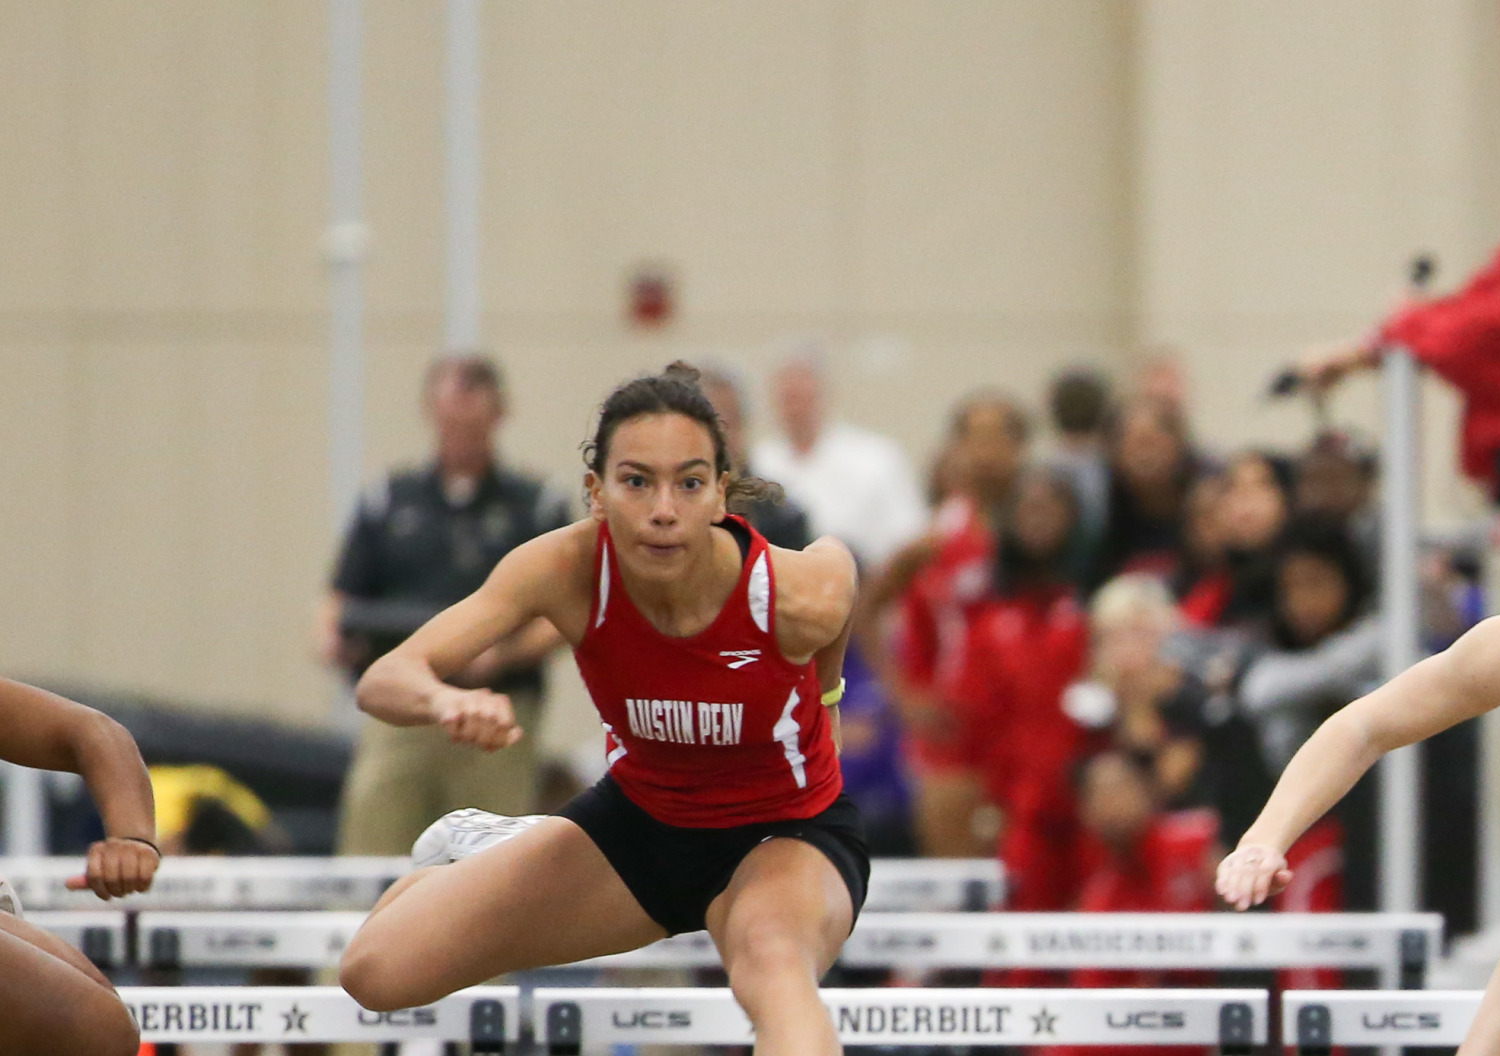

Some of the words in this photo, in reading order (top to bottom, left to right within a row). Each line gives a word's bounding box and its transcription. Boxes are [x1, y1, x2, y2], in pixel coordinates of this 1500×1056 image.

[625, 698, 695, 744] AUSTIN
[698, 702, 744, 746] PEAY
[128, 1003, 261, 1031] ERBILT
[612, 1010, 692, 1029] UCS
[839, 1006, 1011, 1034] NDERBILT
[1106, 1011, 1186, 1030] UCS
[1361, 1012, 1441, 1031] UCS
